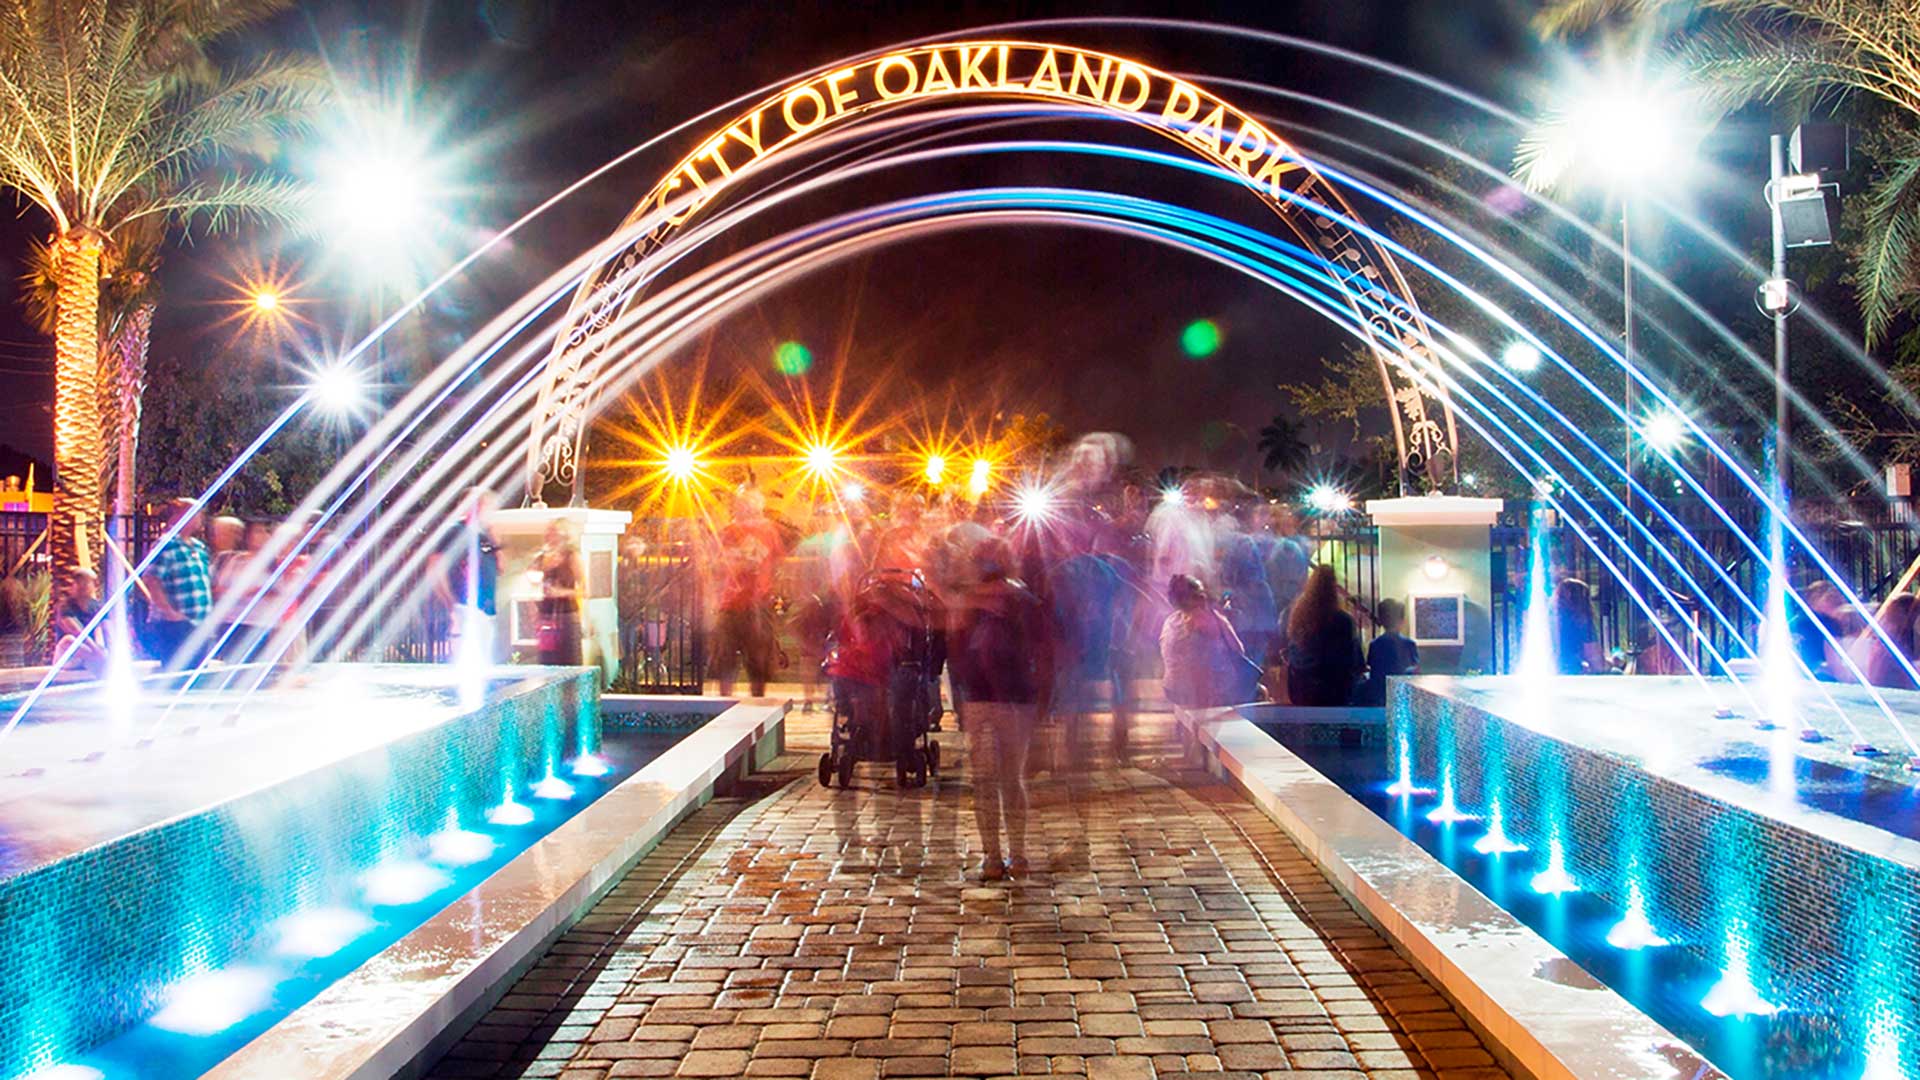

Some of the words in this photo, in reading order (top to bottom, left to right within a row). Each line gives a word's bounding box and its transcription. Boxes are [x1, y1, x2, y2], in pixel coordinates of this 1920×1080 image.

[656, 109, 764, 225] CITY
[783, 69, 858, 133] OF
[874, 45, 1150, 112] OAKLAND
[1160, 80, 1305, 203] PARK
